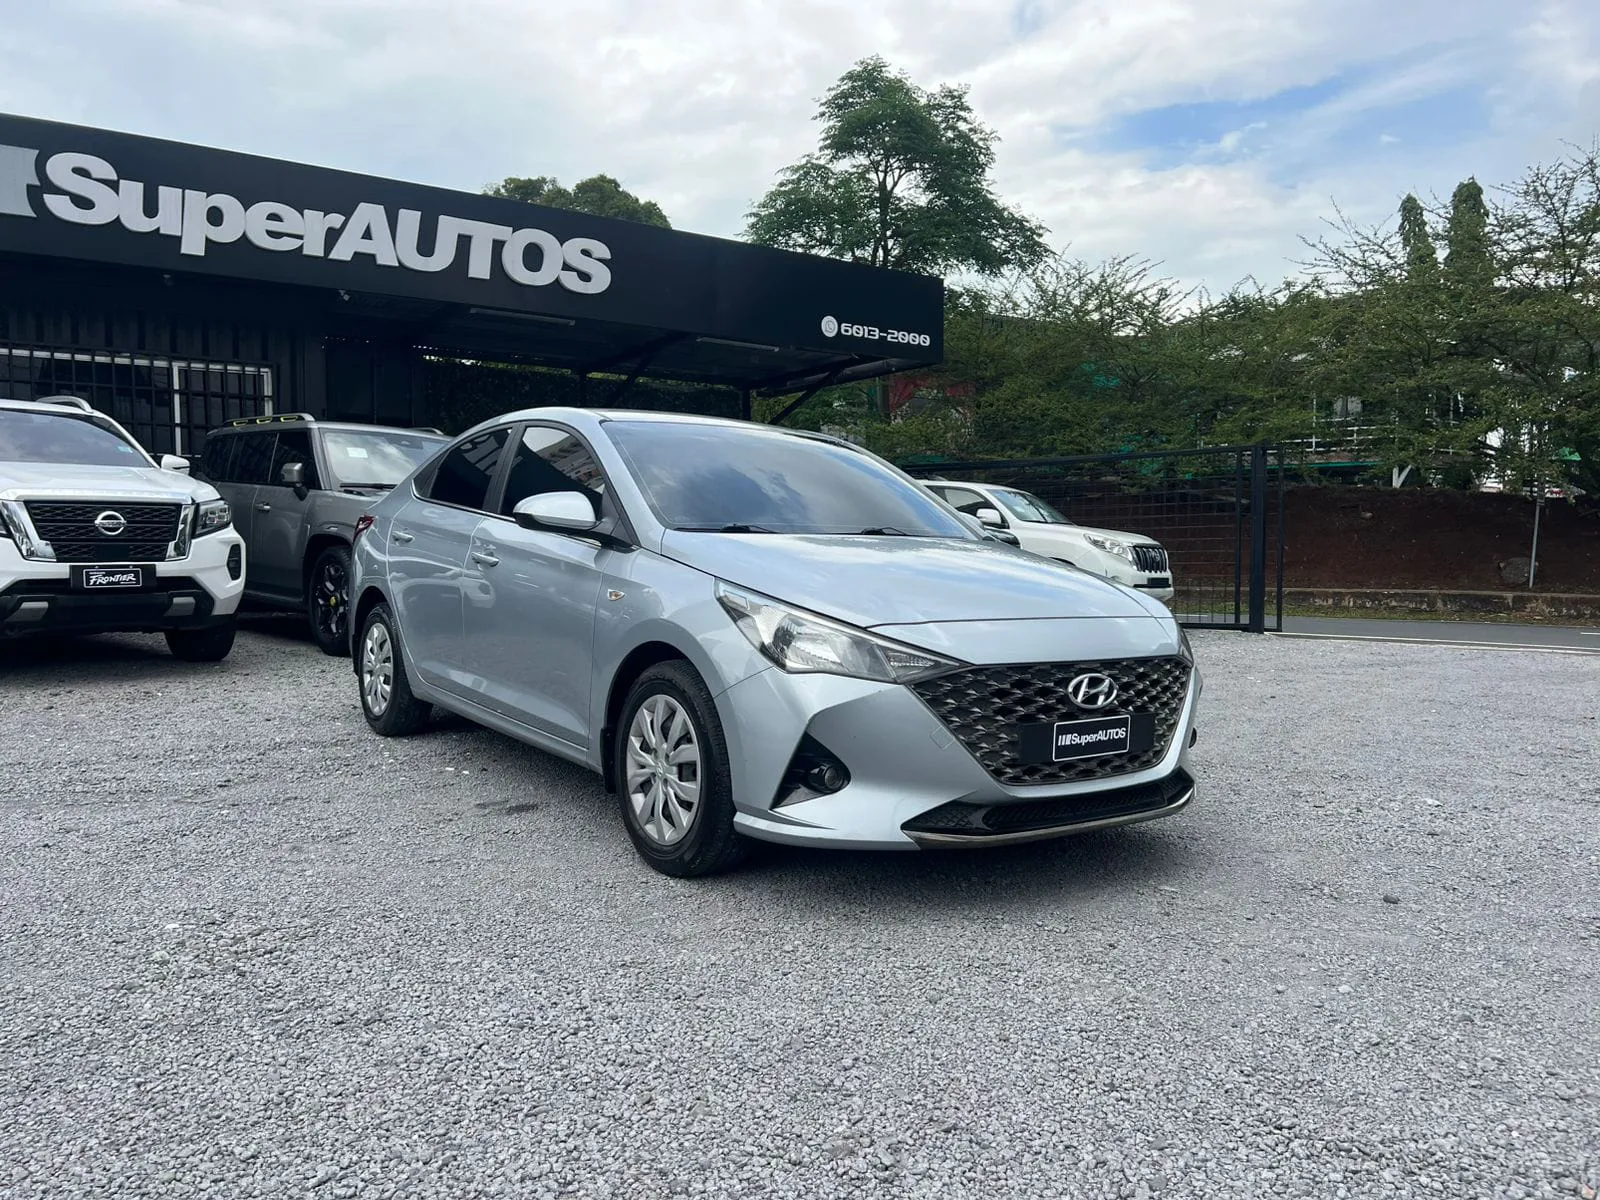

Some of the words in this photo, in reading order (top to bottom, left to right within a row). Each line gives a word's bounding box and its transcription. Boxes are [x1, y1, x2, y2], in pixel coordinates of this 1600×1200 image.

[43, 151, 612, 294] SuperAUTOS
[840, 322, 931, 346] 6013-2000
[1071, 727, 1127, 746] SuperAUTOS
